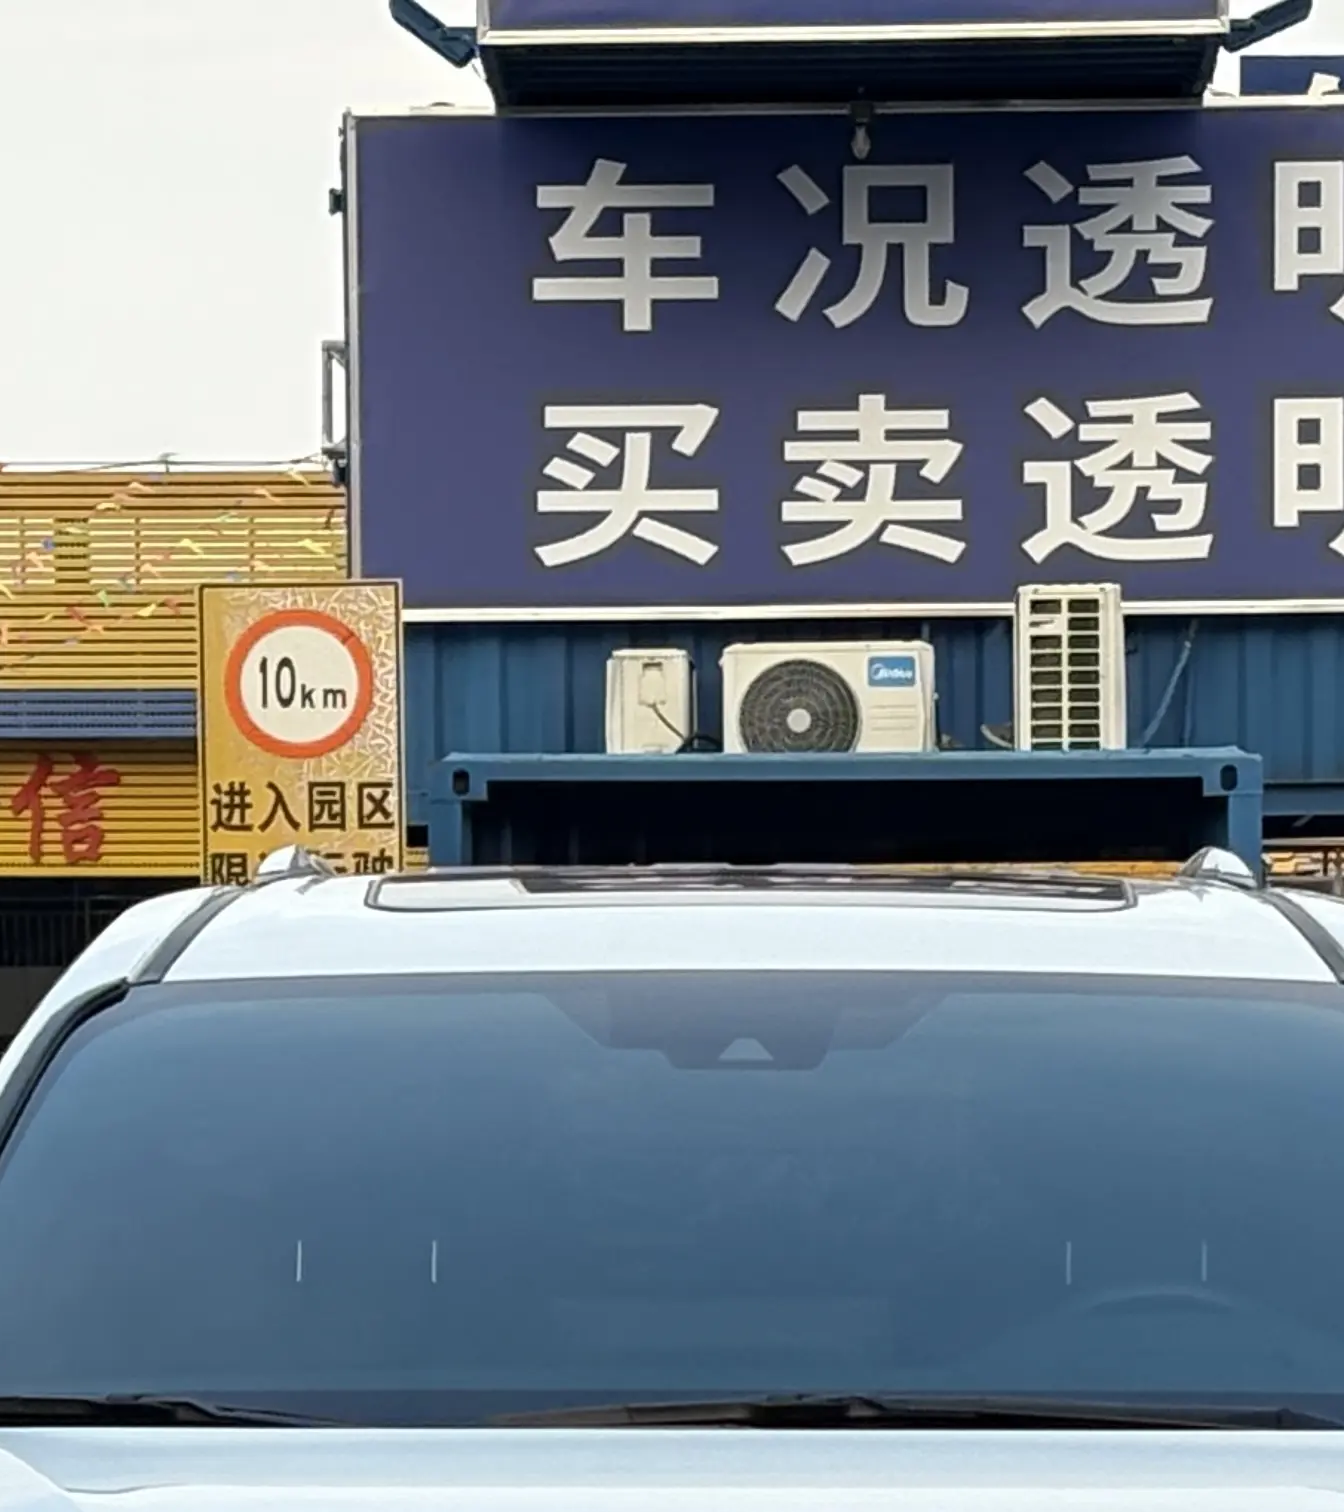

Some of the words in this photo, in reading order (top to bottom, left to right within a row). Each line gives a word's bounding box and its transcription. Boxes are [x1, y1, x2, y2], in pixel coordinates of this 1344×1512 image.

[258, 655, 348, 709] 10km
[209, 780, 396, 833] 进入园区
